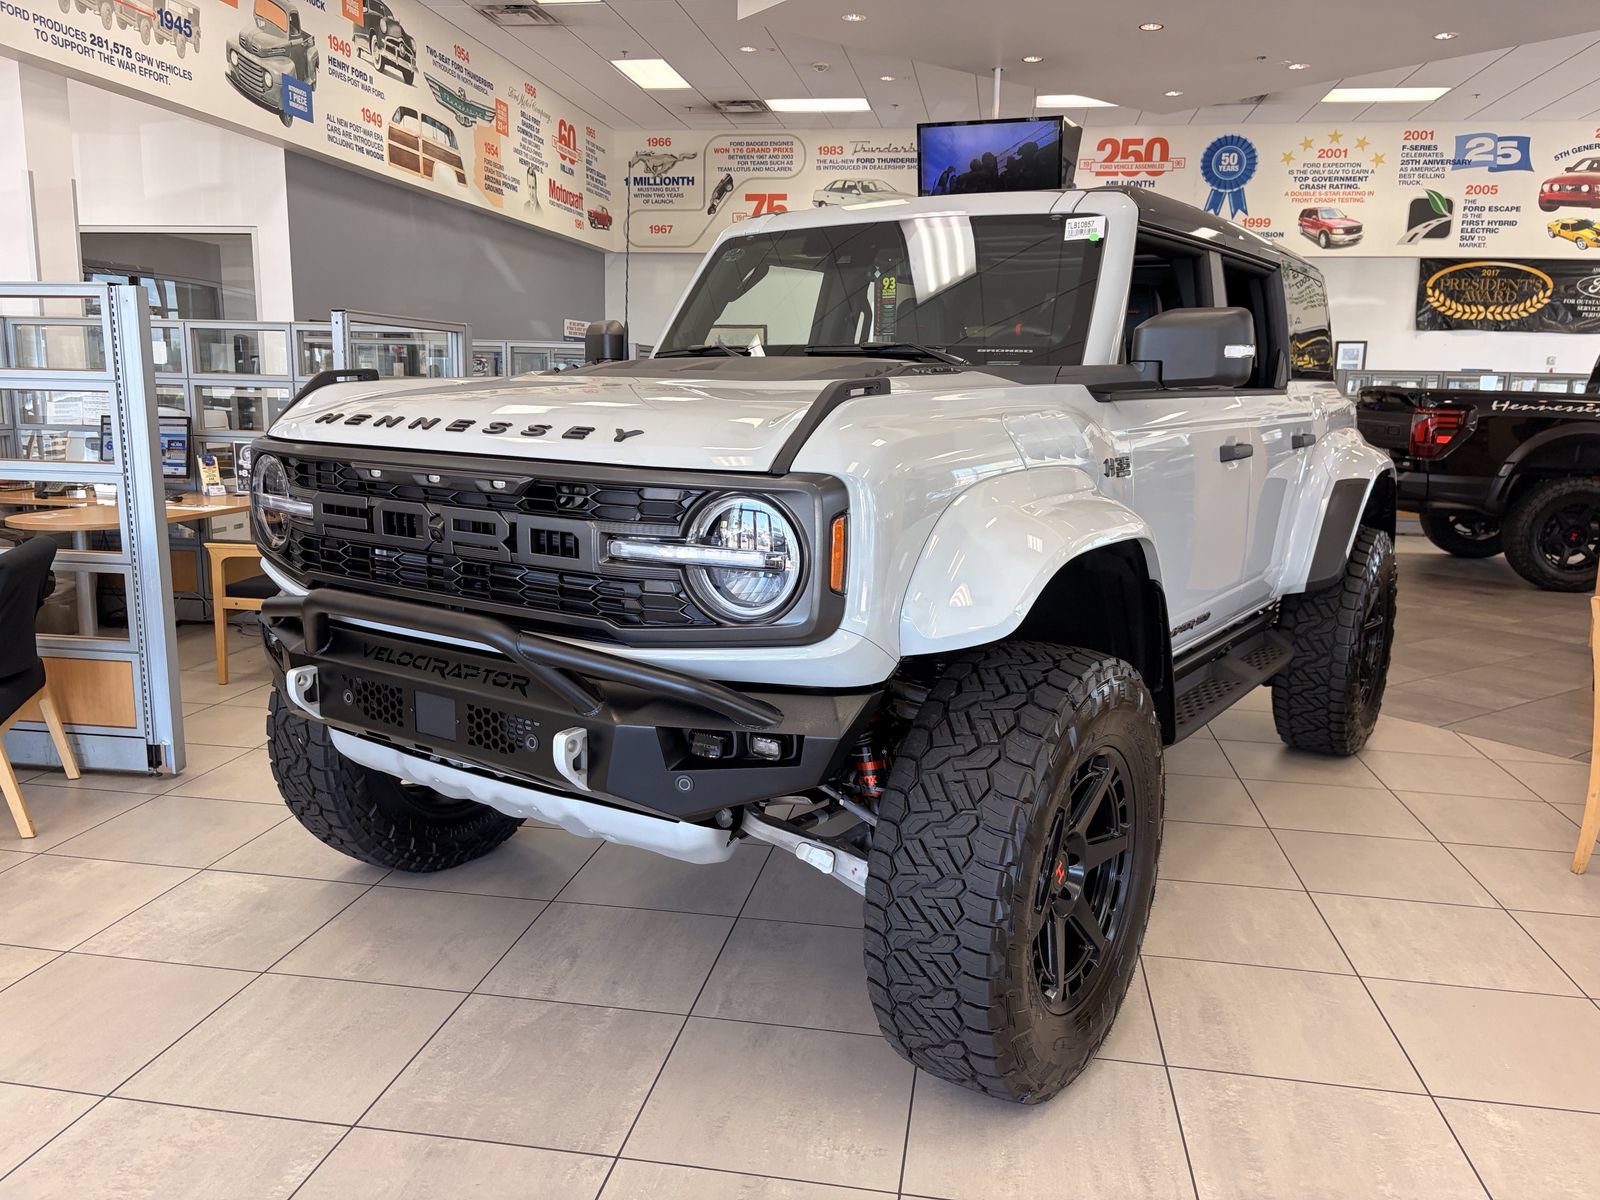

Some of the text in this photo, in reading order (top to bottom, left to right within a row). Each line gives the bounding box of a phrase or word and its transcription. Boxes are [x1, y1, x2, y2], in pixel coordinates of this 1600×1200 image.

[156, 8, 192, 38] 1945
[0, 1, 193, 81] FORD PRODUCES 281,578 GPW VEHICLES
[327, 34, 352, 58] 1949
[34, 27, 171, 86] TO SUPPORT THE WAR EFFORT.
[425, 45, 451, 66] TWO-SEAT
[451, 60, 464, 73] FORD
[453, 44, 470, 64] 1954
[328, 55, 368, 82] HENRY FORD
[328, 66, 347, 82] DRIVES
[347, 76, 360, 89] POST
[360, 81, 372, 95] WAR
[326, 113, 336, 124] ALL
[336, 116, 348, 129] NEW
[374, 131, 384, 142] ERA
[361, 106, 383, 129] 1949
[326, 123, 385, 152] CARS ARE INTRODUCED
[327, 134, 354, 151] INCLUDING
[354, 144, 365, 154] THE
[558, 118, 577, 166] 60
[646, 137, 672, 147] 1966
[1403, 130, 1434, 140] 2001
[484, 141, 499, 158] 1954
[817, 145, 844, 155] 1983
[849, 141, 918, 156] Thunderb
[1095, 137, 1169, 177] 250
[1221, 153, 1238, 165] 50
[1317, 148, 1348, 159] 2001
[1464, 137, 1522, 165] 25
[1553, 143, 1600, 161] 5TH GENER
[633, 176, 695, 187] MILLIONTH
[1465, 185, 1499, 195] 2005
[548, 178, 584, 212] Motorcraft
[745, 193, 788, 217] 75
[648, 225, 673, 234] 1967
[1242, 218, 1271, 228] 1999
[882, 277, 896, 289] 93
[1440, 277, 1543, 292] PRESIDENT'S
[1460, 290, 1517, 303] AWARD
[314, 412, 645, 443] HENNESSEY
[363, 643, 531, 698] VELOCIRAPTOR
